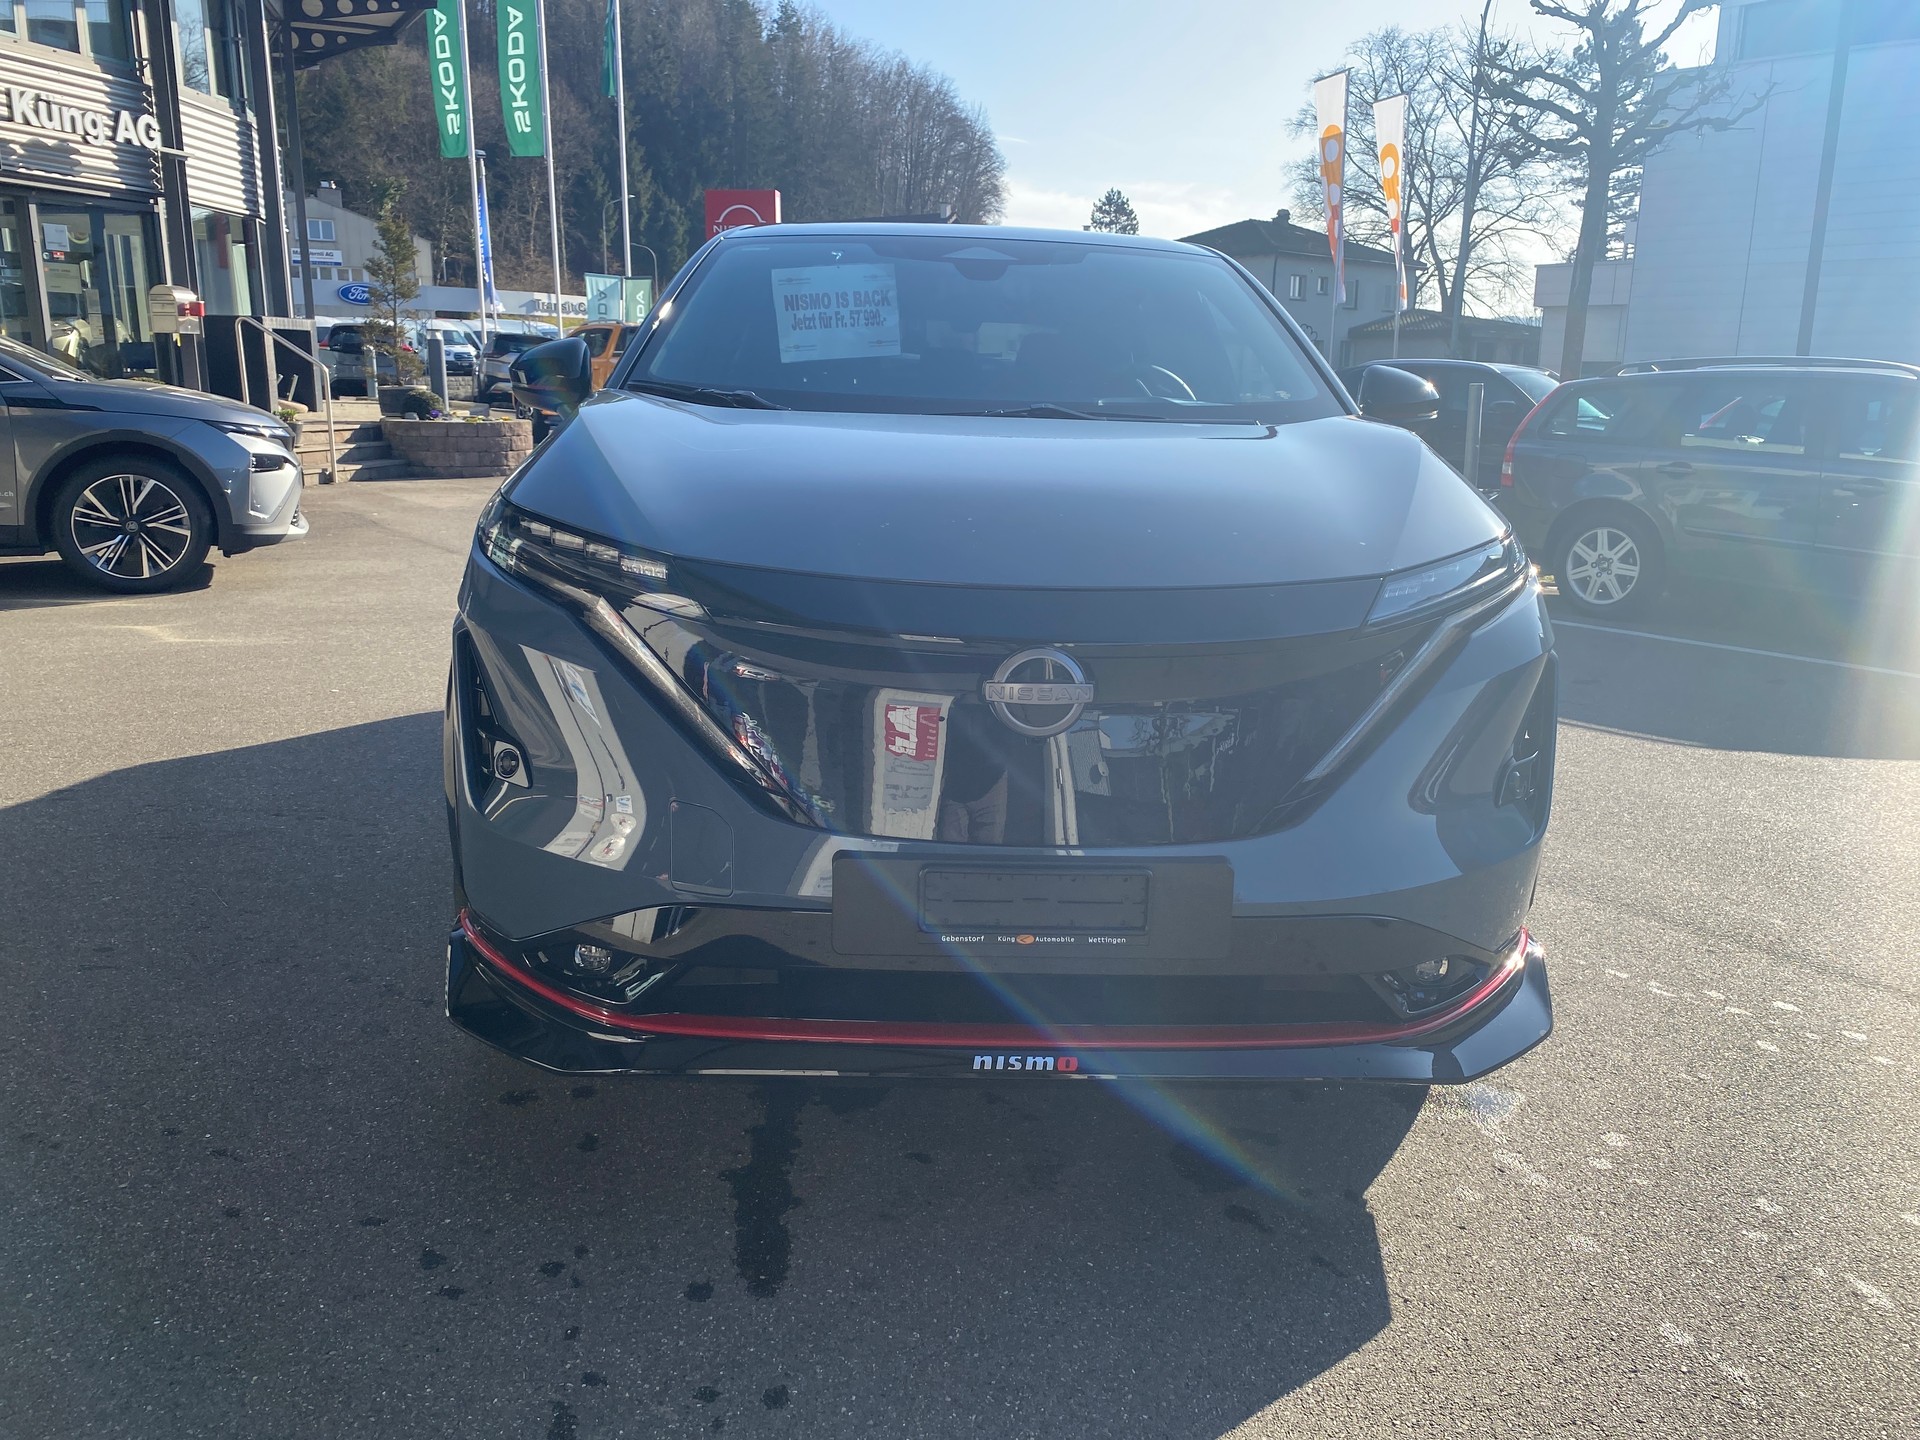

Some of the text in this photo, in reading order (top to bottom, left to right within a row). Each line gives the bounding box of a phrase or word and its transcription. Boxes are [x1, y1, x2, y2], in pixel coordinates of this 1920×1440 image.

[9, 87, 162, 149] Küng AG
[783, 289, 892, 312] NISMO IS BACK
[791, 313, 817, 331] Jetzt
[818, 311, 833, 329] für
[835, 310, 848, 328] Fr.
[988, 685, 1091, 701] NISSAN
[997, 935, 1016, 943] Küng
[1088, 936, 1127, 944] Wettingen
[973, 1055, 1079, 1072] nismo
